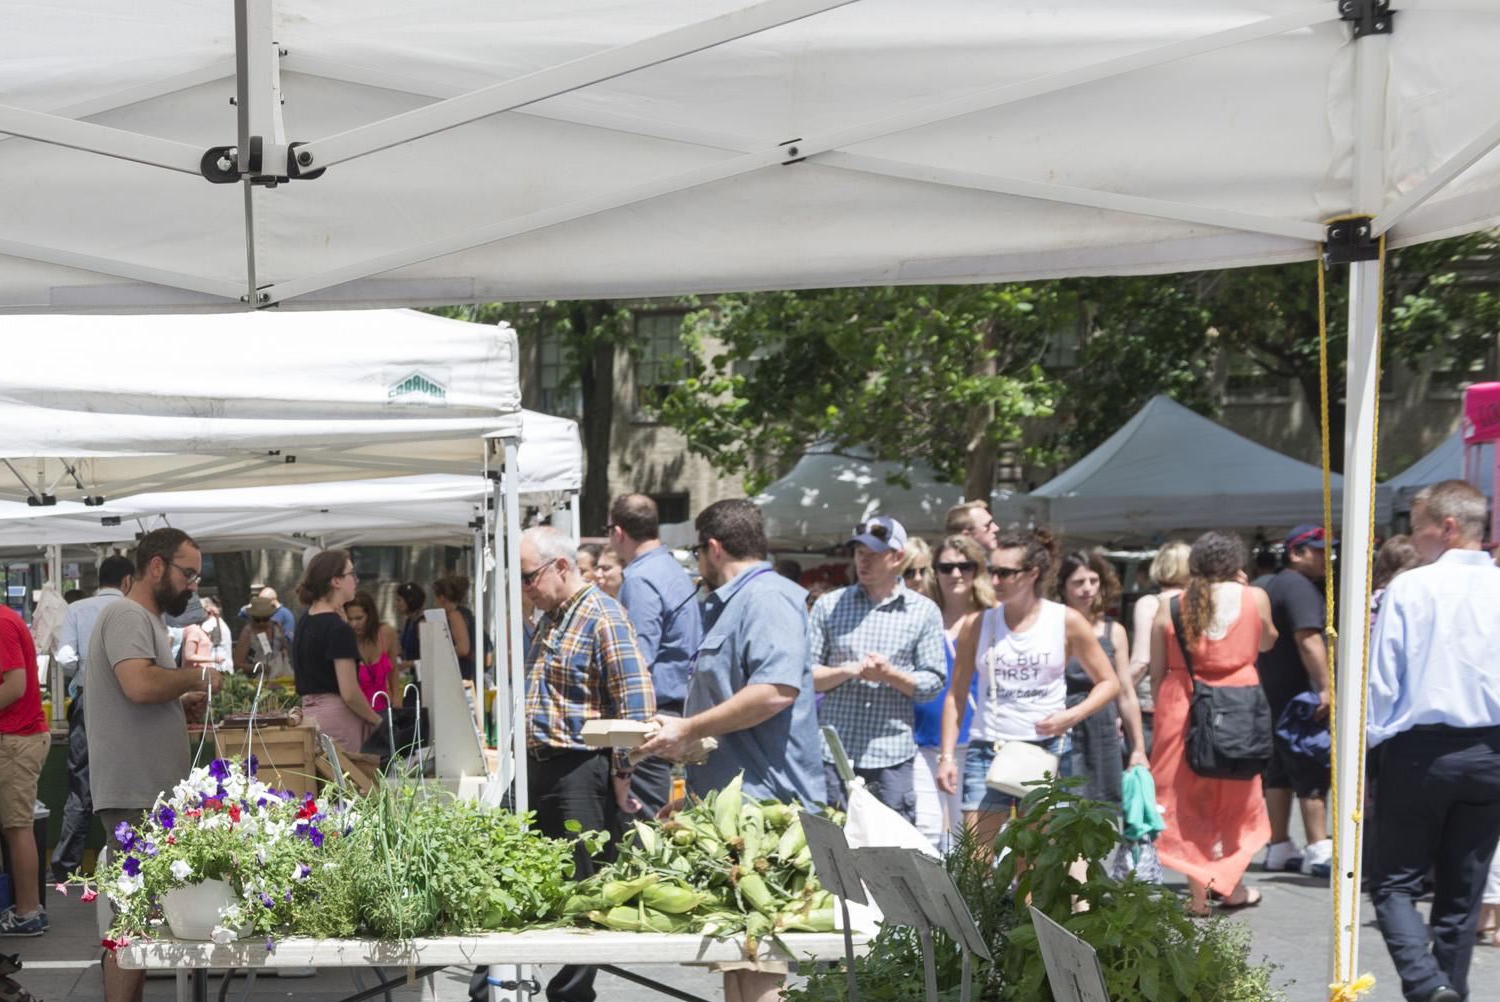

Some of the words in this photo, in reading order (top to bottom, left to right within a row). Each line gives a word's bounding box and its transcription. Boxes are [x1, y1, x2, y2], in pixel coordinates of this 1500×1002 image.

[388, 374, 446, 399] CARAVAN
[1017, 653, 1051, 666] BUT
[995, 667, 1041, 681] FIRST
